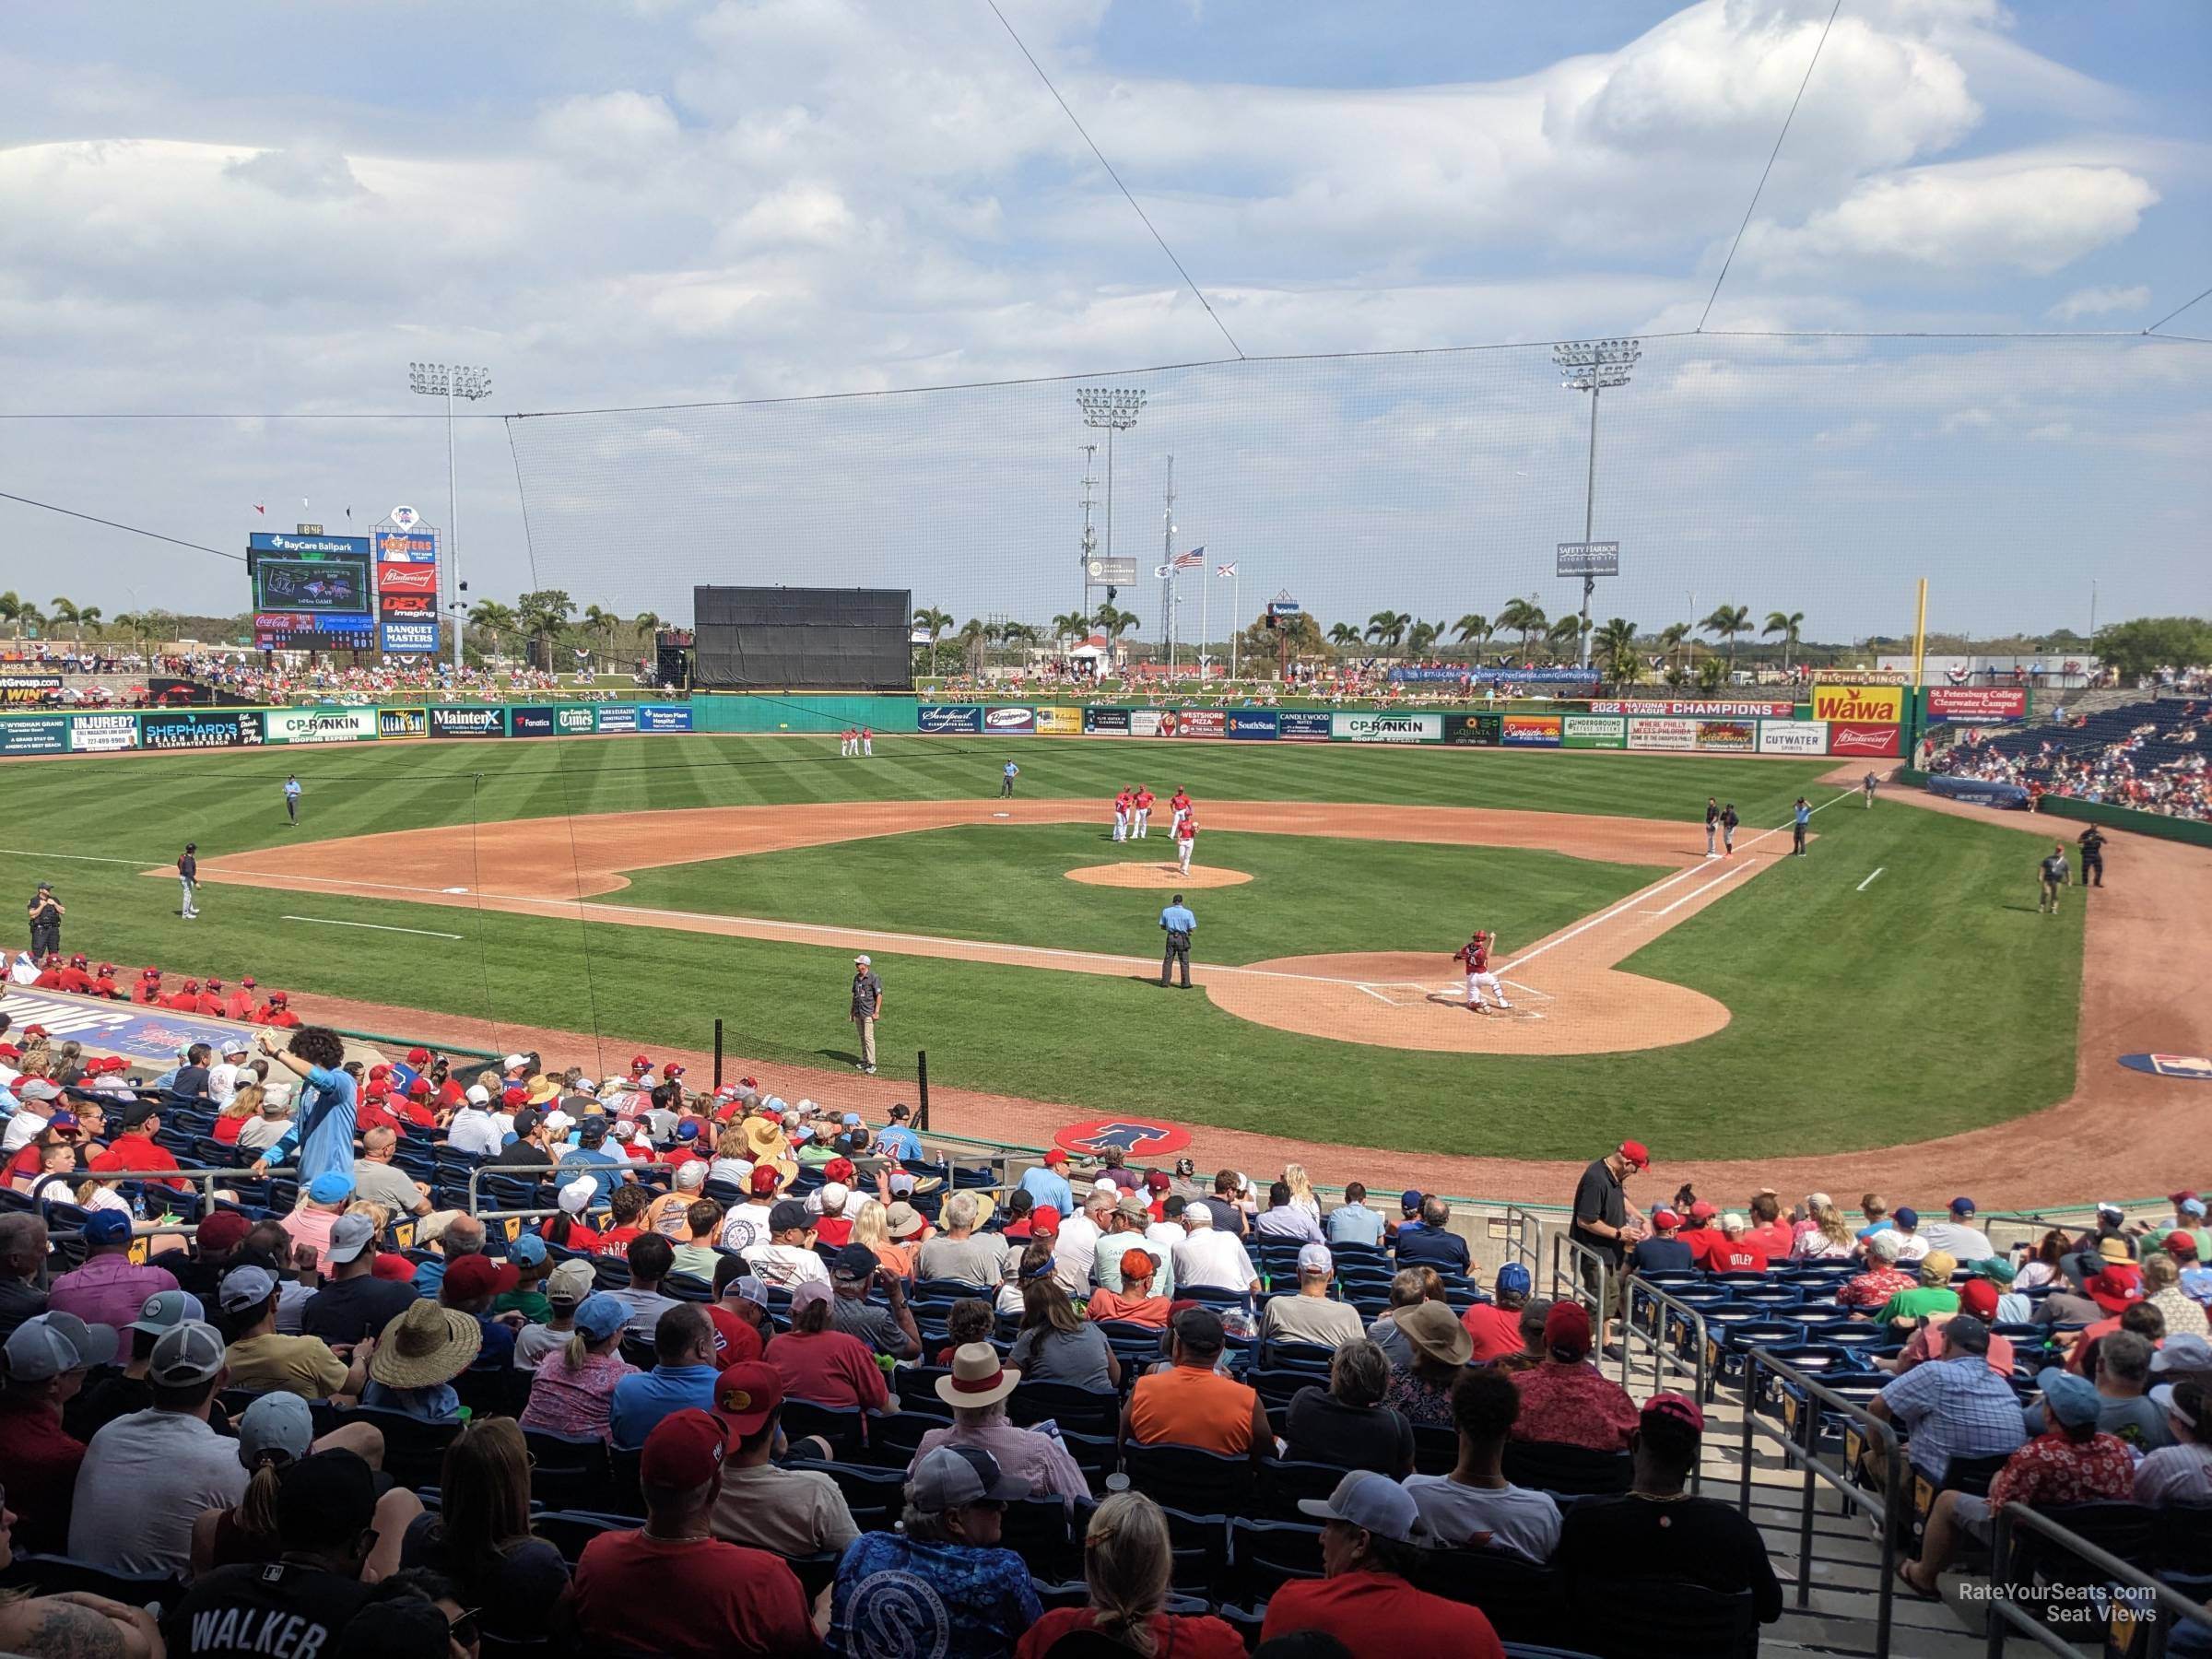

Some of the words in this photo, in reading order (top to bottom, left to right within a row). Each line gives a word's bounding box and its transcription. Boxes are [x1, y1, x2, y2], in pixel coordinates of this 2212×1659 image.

[284, 540, 318, 551] BayCare
[319, 541, 352, 552] Ballpark
[387, 572, 429, 582] Budweiser
[382, 596, 431, 610] DEX
[394, 609, 436, 618] imaging
[386, 626, 433, 634] BANQUET
[386, 634, 433, 642] MASTERS
[1814, 674, 1868, 683] BELCHER
[1869, 676, 1905, 684] BINGO
[1930, 689, 1941, 698] St.
[1943, 689, 1989, 700] Petersburg
[1990, 690, 2023, 700] College
[1592, 702, 1620, 713] 2022
[1672, 703, 1772, 715] CHAMPIONS
[1818, 698, 1894, 721] Wawa
[1934, 699, 1980, 707] Clearwater
[1982, 700, 2018, 709] Campus
[433, 710, 500, 727] MaintenX
[559, 711, 593, 726] Times
[923, 707, 976, 722] Sandpearl
[74, 716, 135, 729] INJURED?
[286, 717, 359, 731] CP-RANKIN
[381, 716, 406, 732] CLEAR
[524, 719, 550, 727] Fanatics
[1238, 721, 1276, 730] SouthState
[1349, 721, 1423, 732] CP-RANKIN
[147, 723, 238, 736] SHEPHARD'S
[147, 735, 185, 743] BEACH
[194, 733, 238, 741] RESORT
[249, 735, 263, 744] Play
[1765, 735, 1818, 746] CUTWATER
[1840, 732, 1888, 743] Budweiser
[1730, 1253, 1754, 1266] UTLEY
[191, 1607, 328, 1659] WALKER
